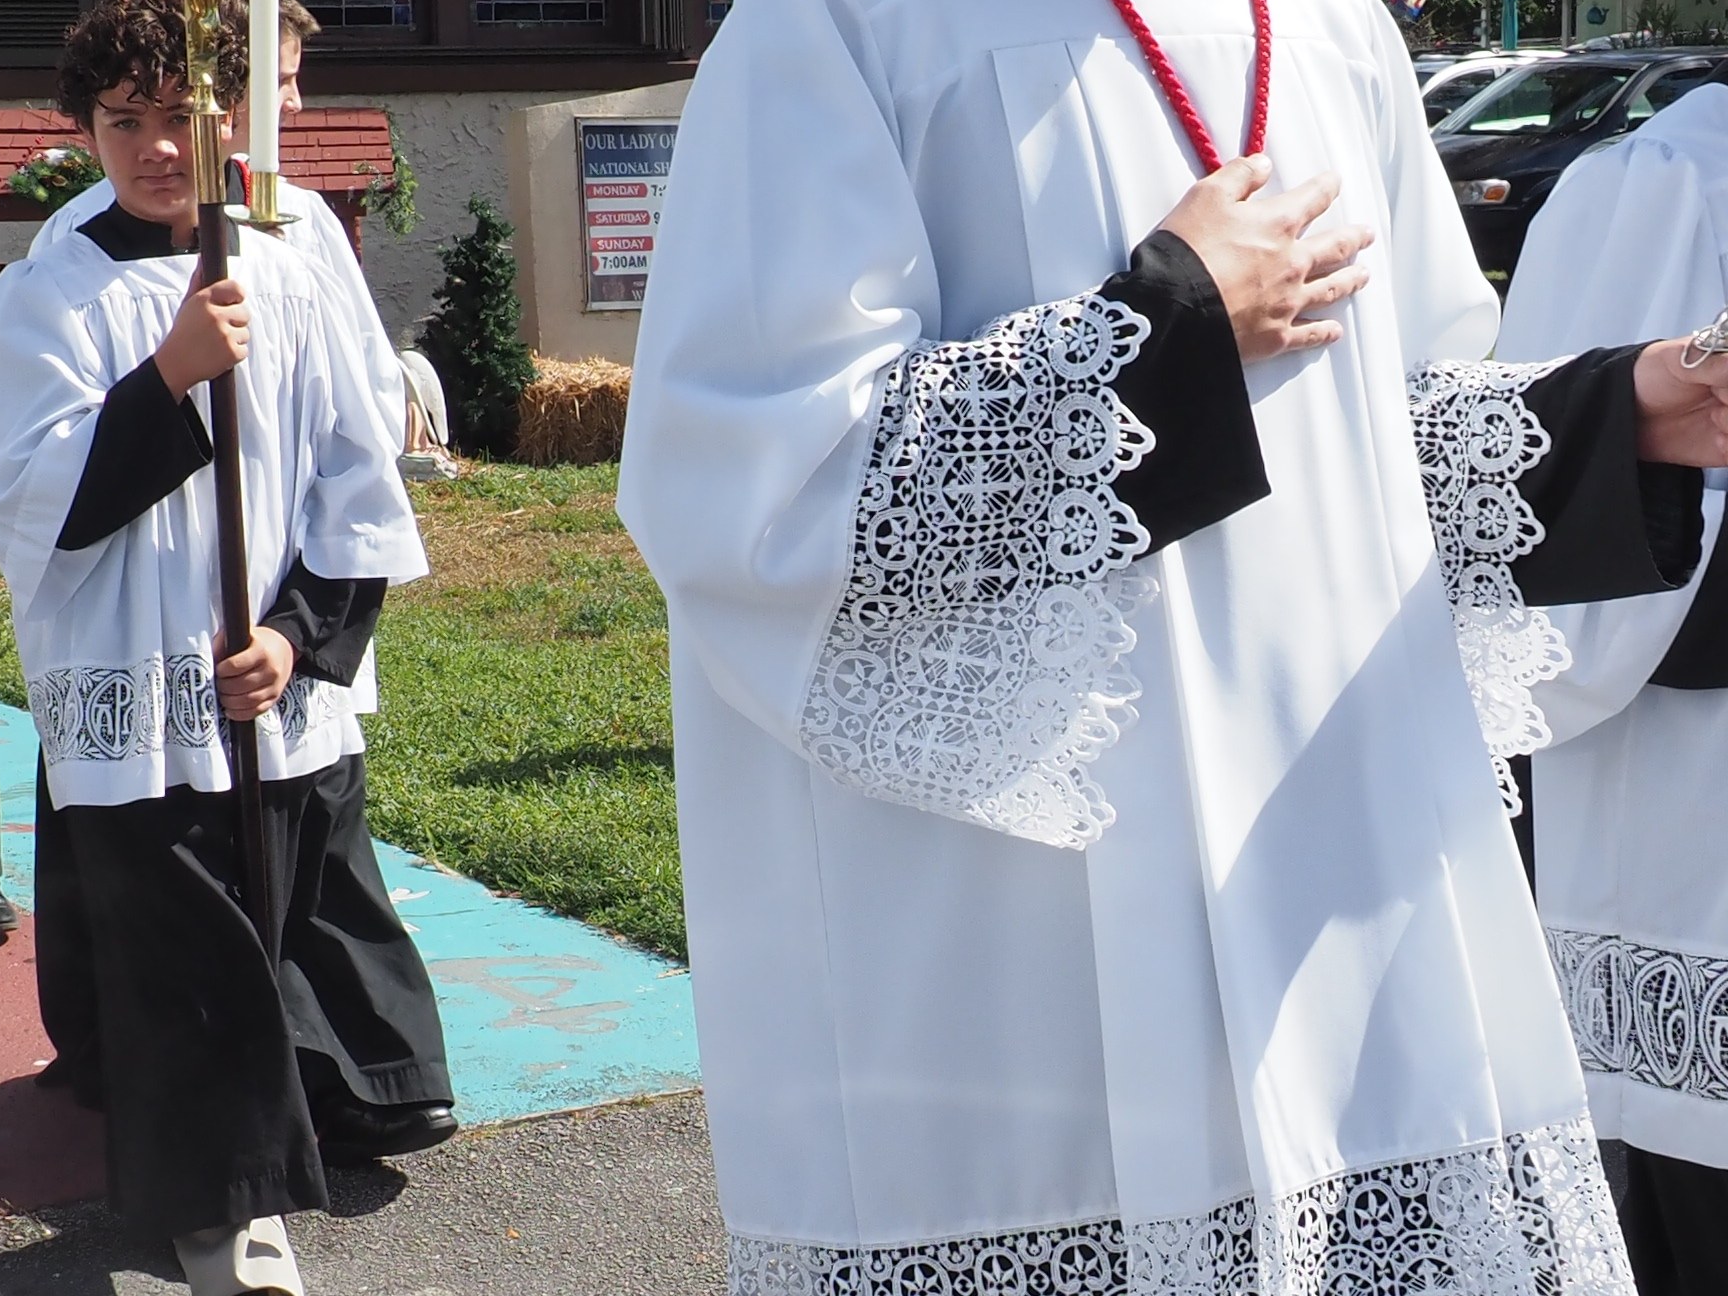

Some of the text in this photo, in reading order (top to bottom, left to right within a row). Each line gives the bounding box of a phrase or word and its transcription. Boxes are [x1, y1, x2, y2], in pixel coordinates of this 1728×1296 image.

[585, 133, 617, 150] OUR
[619, 133, 657, 150] LADY
[589, 161, 653, 175] NATIONAL
[592, 185, 640, 196] MONDAY
[595, 212, 648, 224] SATURDAY
[596, 238, 645, 251] SUNDAY
[600, 255, 648, 270] 7:00AM
